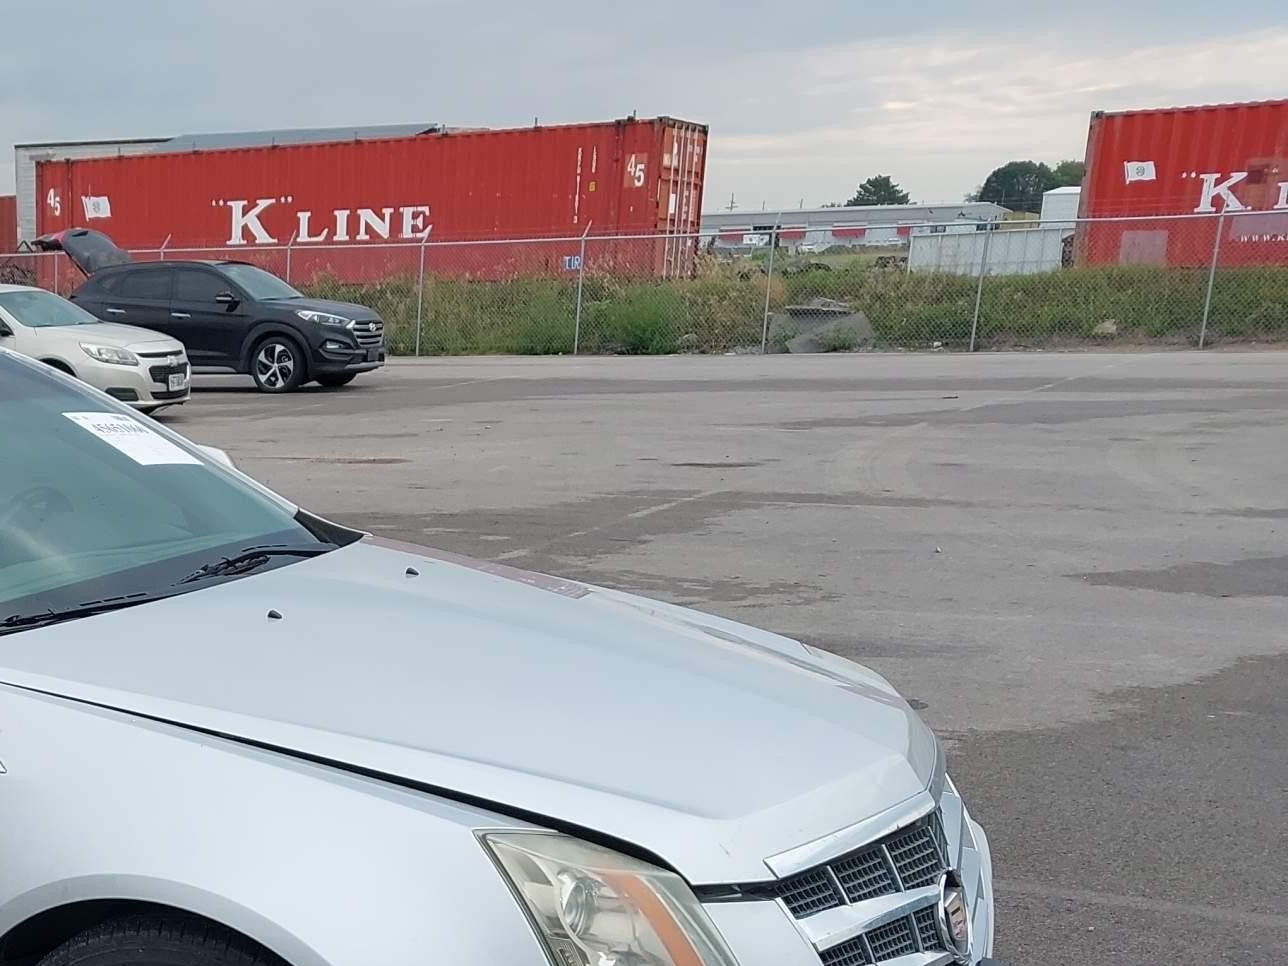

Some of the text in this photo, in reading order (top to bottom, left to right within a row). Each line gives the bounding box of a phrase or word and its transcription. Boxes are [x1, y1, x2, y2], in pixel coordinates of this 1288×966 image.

[627, 153, 645, 187] 45
[47, 187, 61, 216] 45
[296, 206, 432, 242] LINE
[563, 256, 581, 270] TIR
